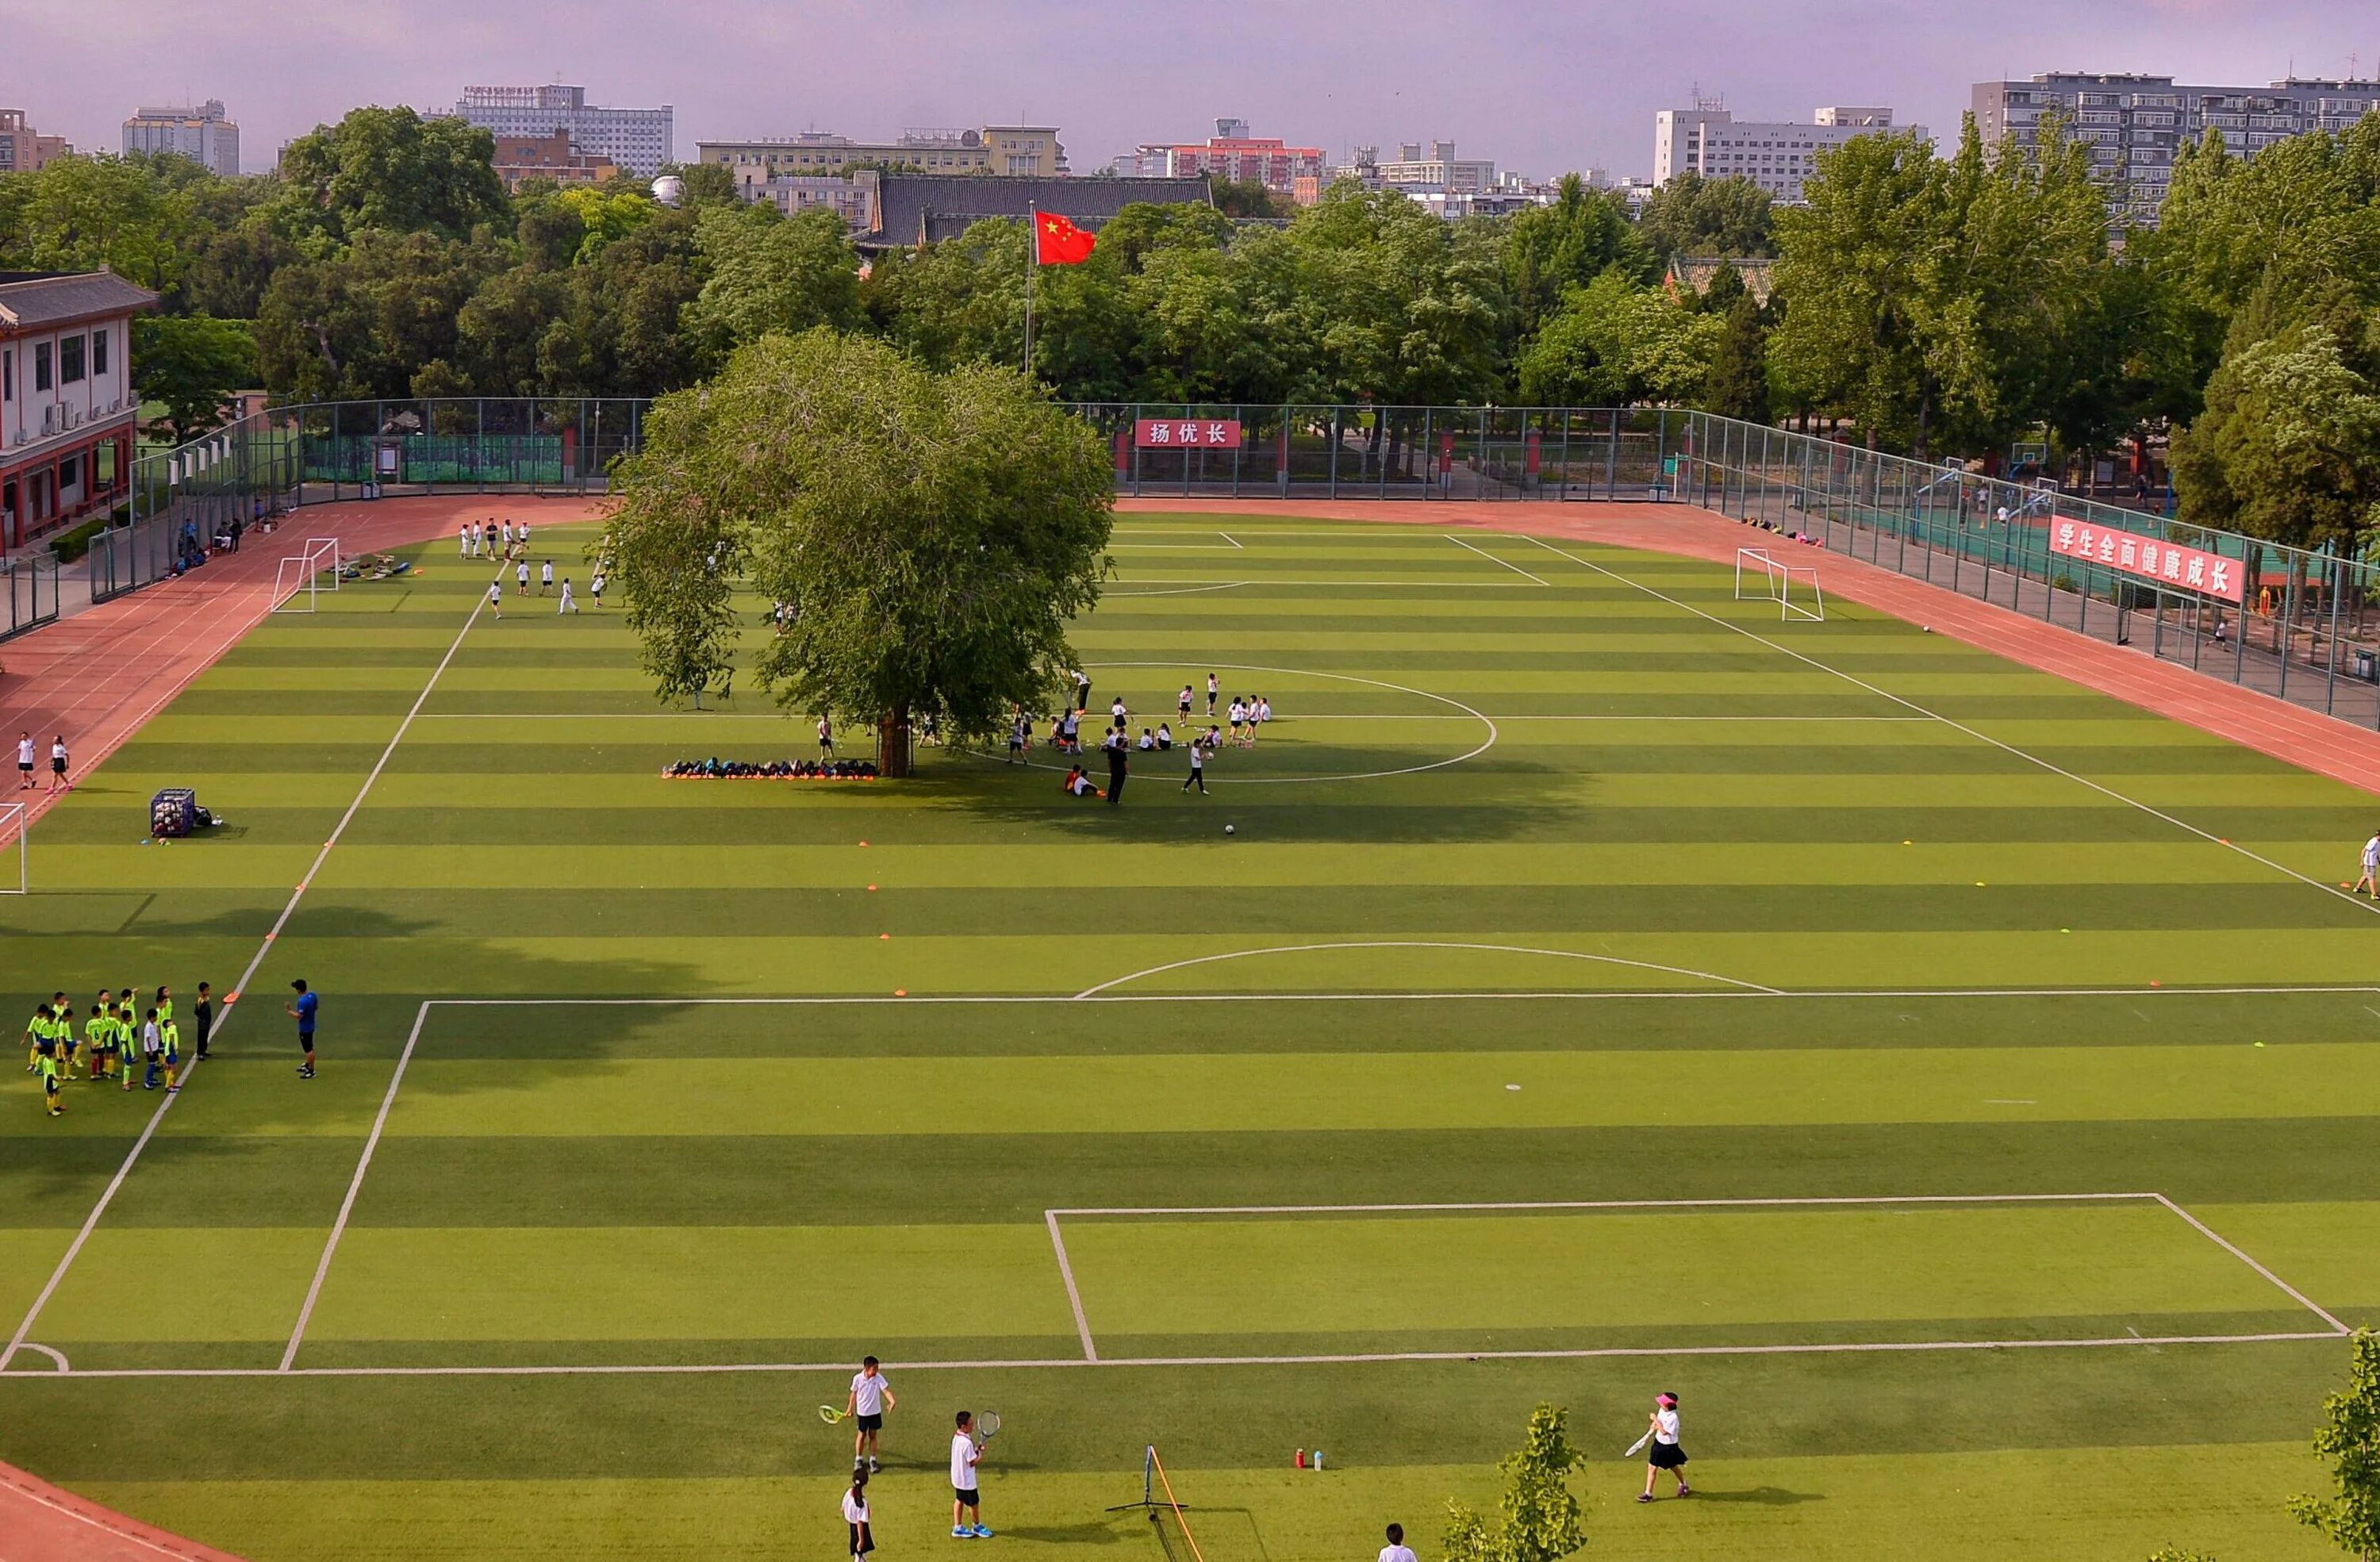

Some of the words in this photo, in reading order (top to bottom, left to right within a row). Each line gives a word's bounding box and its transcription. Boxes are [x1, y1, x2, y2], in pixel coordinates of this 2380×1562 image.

[1150, 424, 1226, 443] 扬优长
[2059, 524, 2229, 593] 学生全面健康成长
